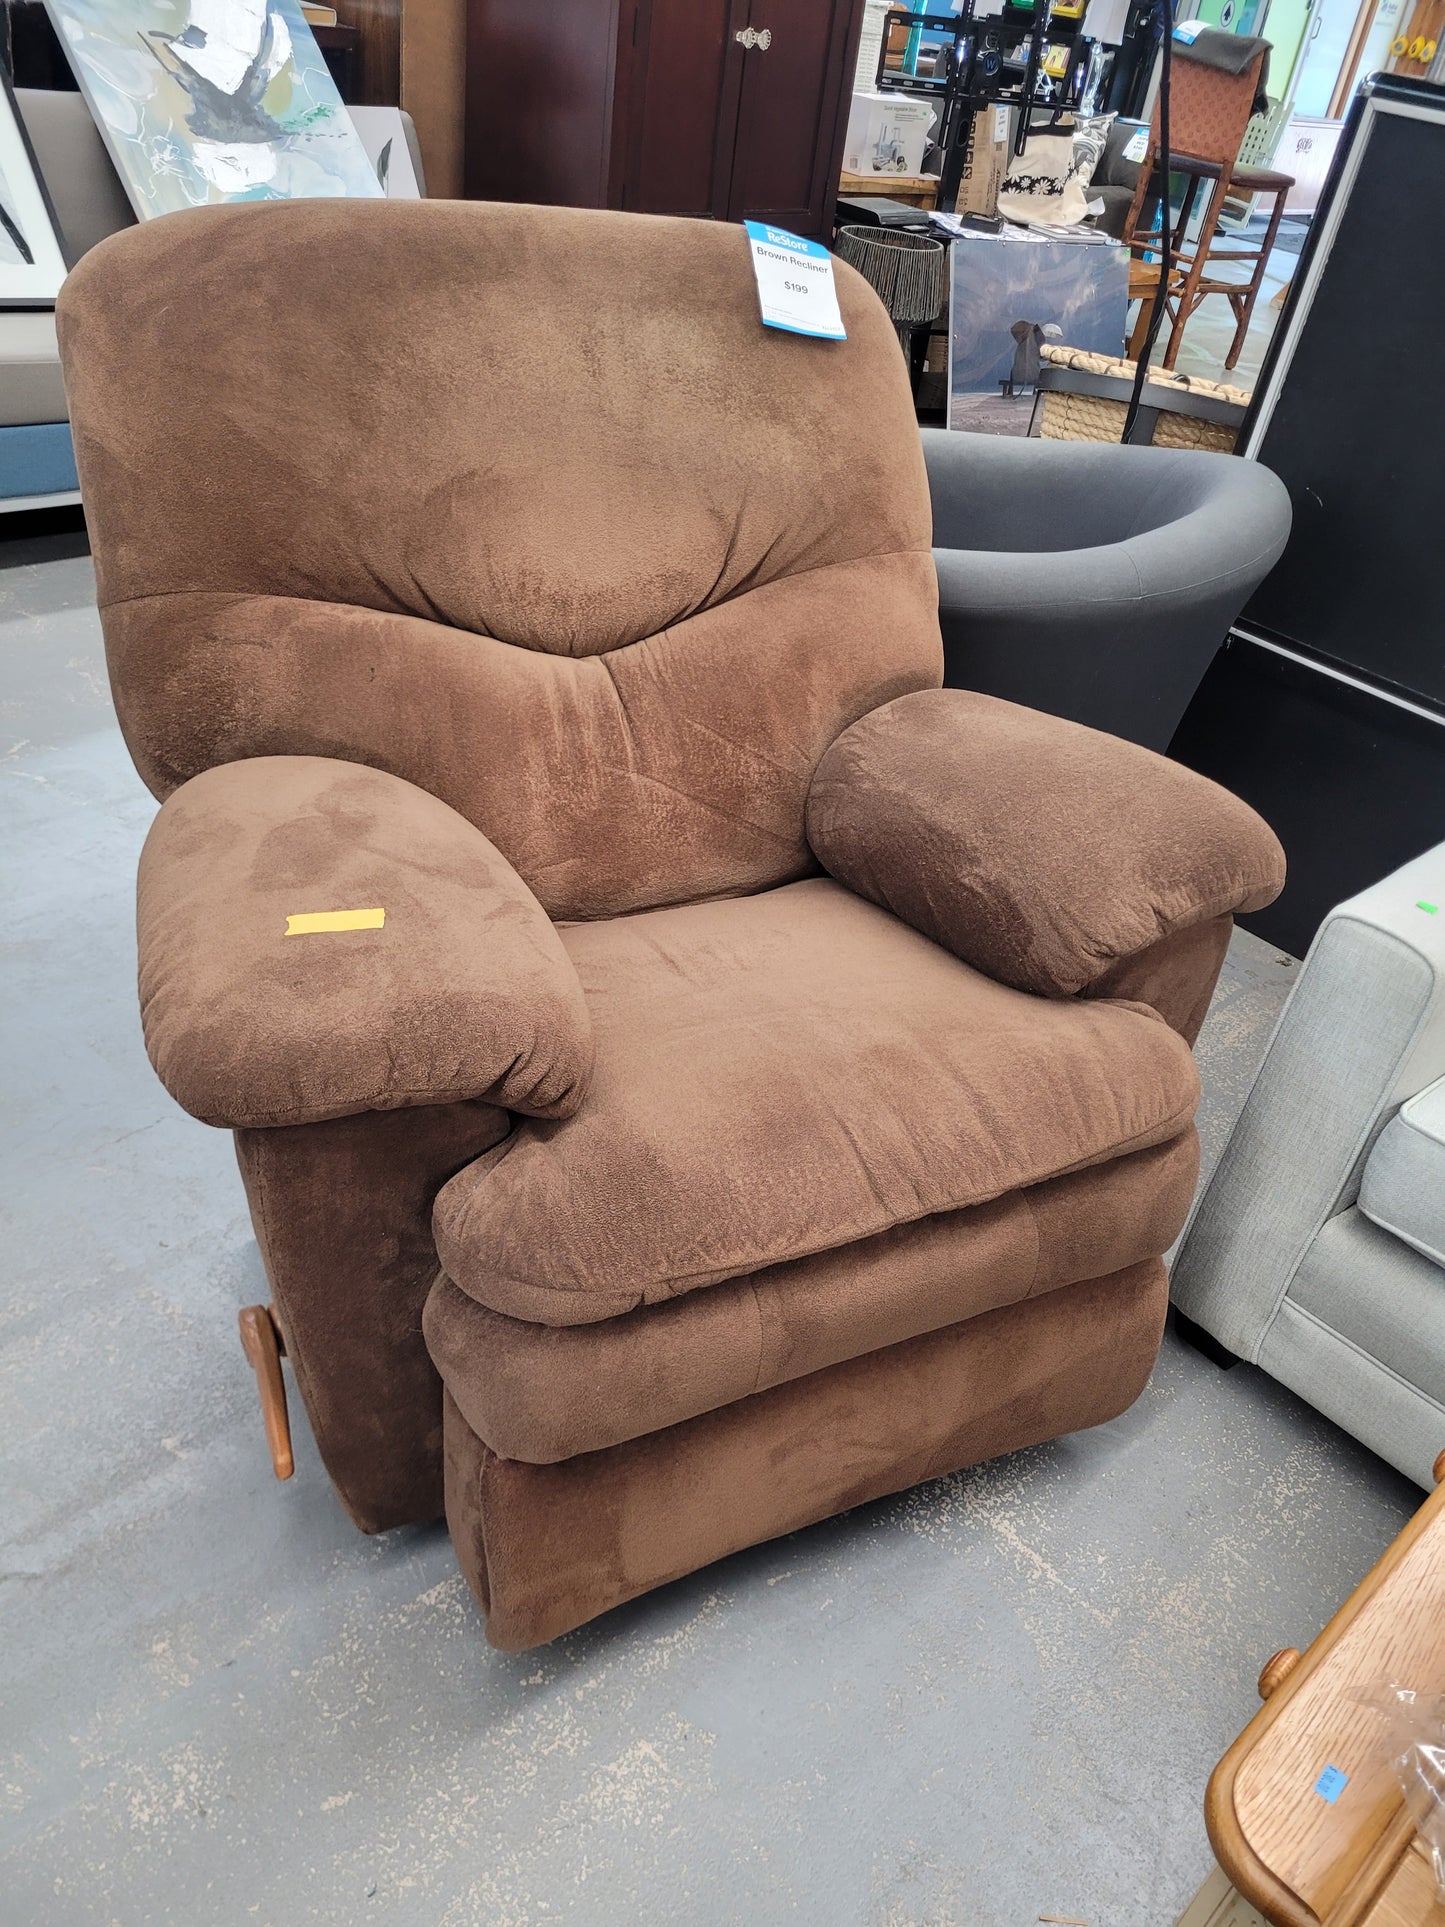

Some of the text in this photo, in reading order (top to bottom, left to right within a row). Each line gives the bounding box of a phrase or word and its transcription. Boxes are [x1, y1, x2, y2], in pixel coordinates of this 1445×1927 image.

[767, 231, 808, 251] ReStore
[757, 246, 828, 274] Brown Recliner
[784, 281, 808, 294] $199
